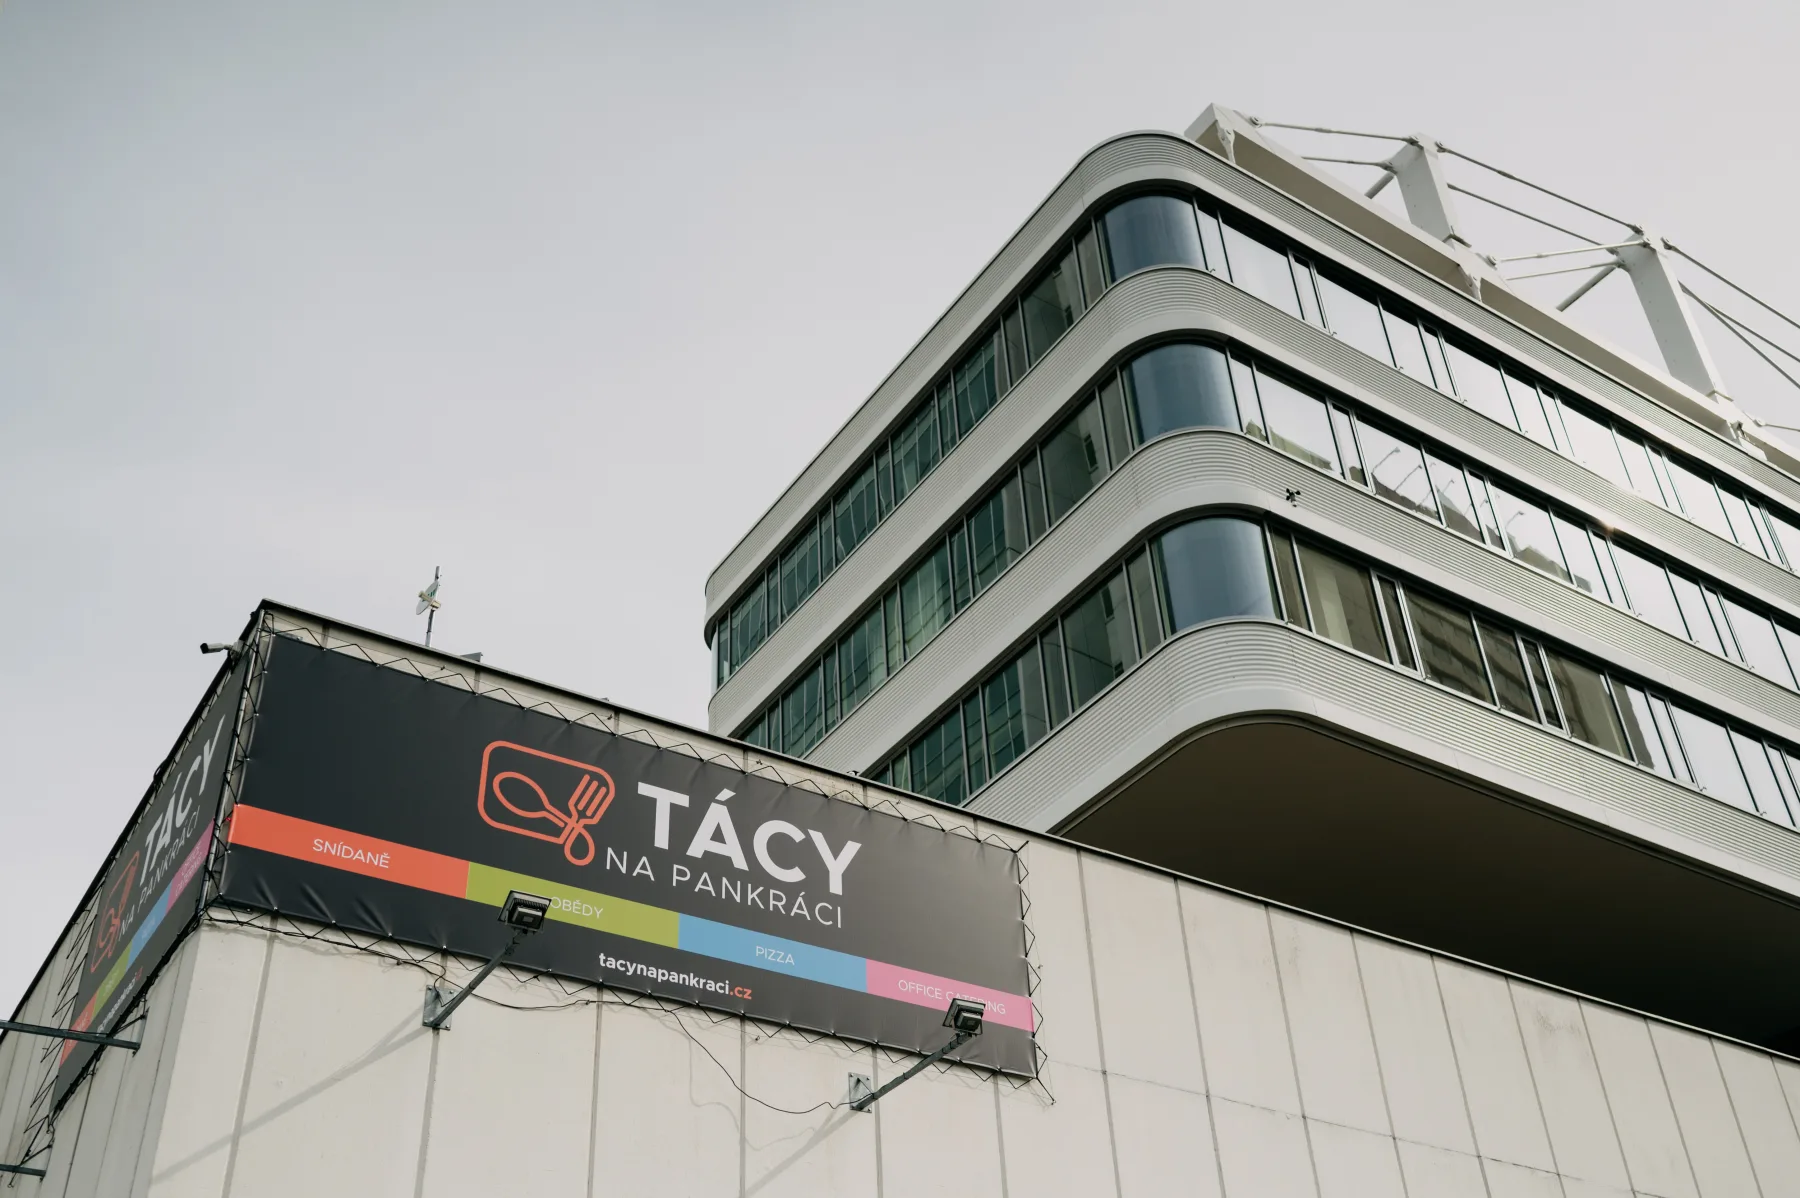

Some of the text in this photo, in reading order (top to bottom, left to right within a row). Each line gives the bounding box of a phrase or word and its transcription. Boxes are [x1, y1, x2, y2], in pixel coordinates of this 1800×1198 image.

[139, 714, 225, 886] TÁCY
[312, 838, 391, 869] SNÍDANĚ
[637, 782, 862, 896] TÁCY
[550, 896, 604, 919] OBĚDY
[606, 847, 843, 929] NA PANKRÁCI
[755, 945, 795, 966] PIZZA
[599, 953, 753, 1000] tacynapankraci.cz
[898, 979, 942, 1000] OFFICE
